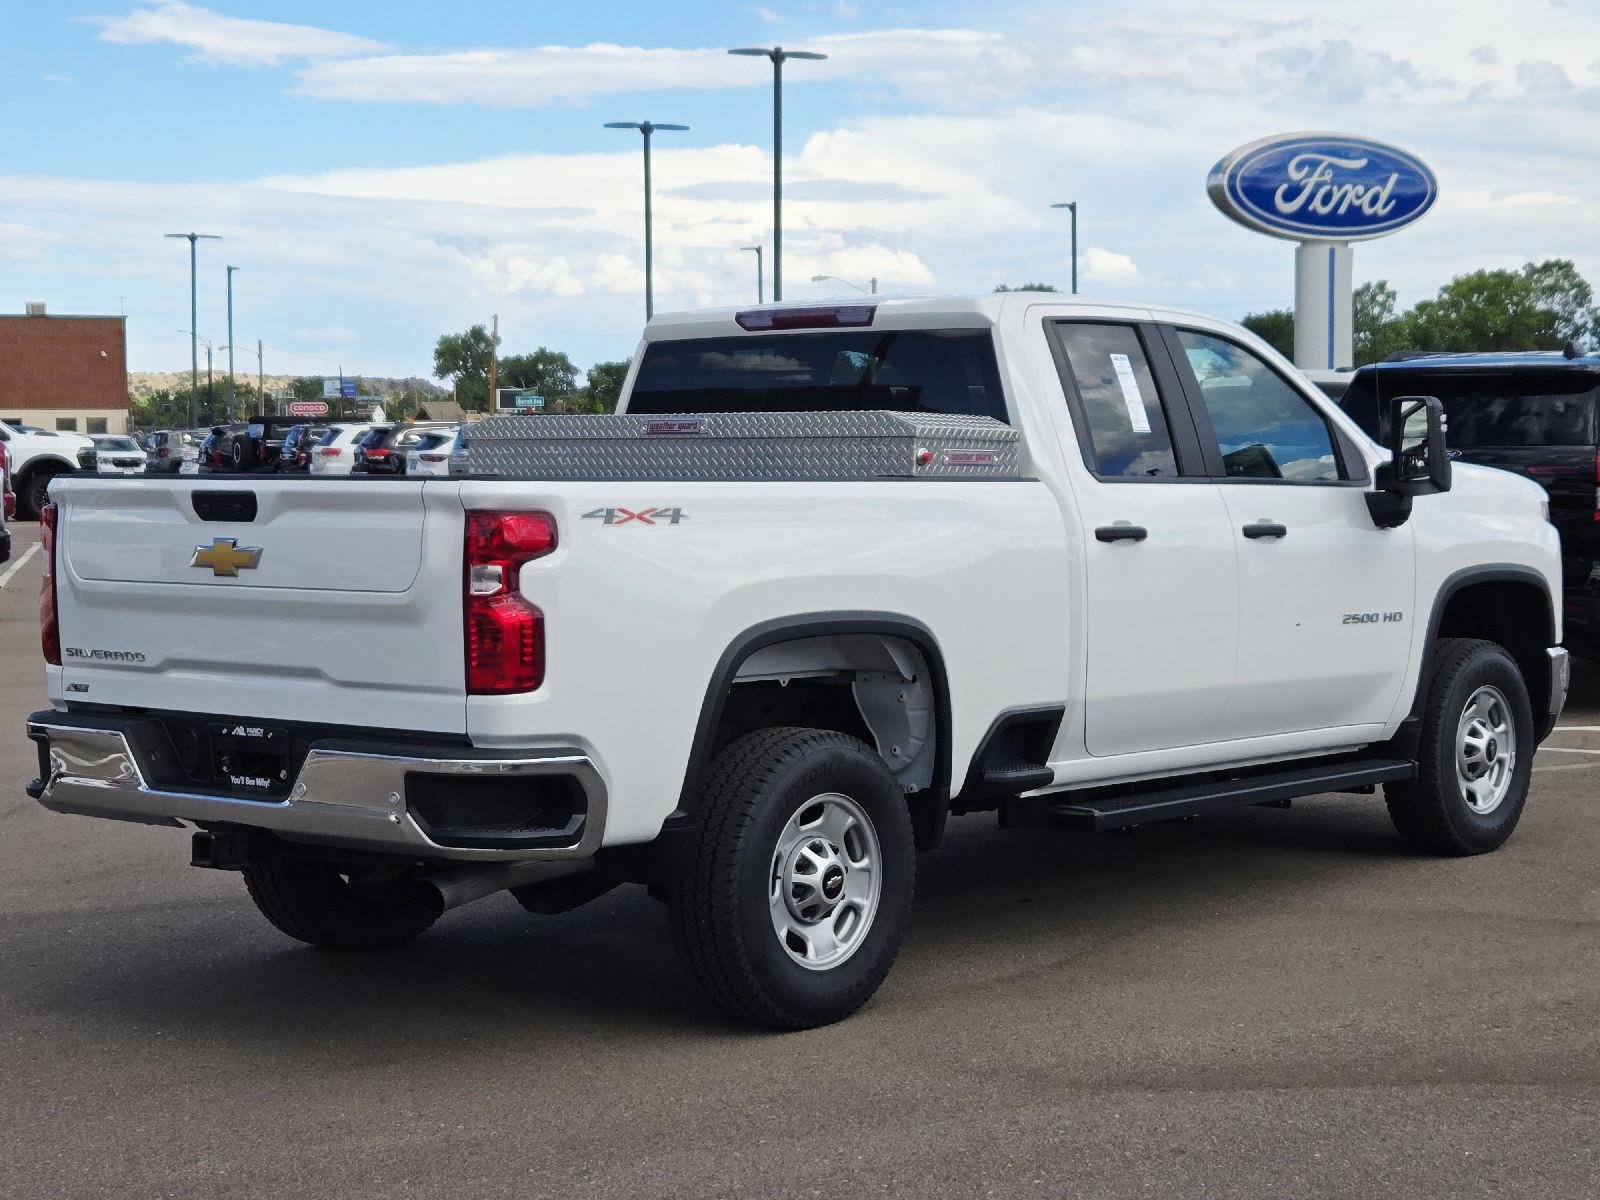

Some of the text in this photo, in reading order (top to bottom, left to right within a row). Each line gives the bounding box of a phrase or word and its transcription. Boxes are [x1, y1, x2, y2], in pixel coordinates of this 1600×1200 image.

[1274, 153, 1399, 216] Ford
[650, 421, 698, 431] weather guard
[950, 453, 974, 461] weather
[1342, 611, 1403, 625] 2500 HD
[65, 647, 146, 662] SILVERADO
[230, 775, 271, 789] You'll See Why!
